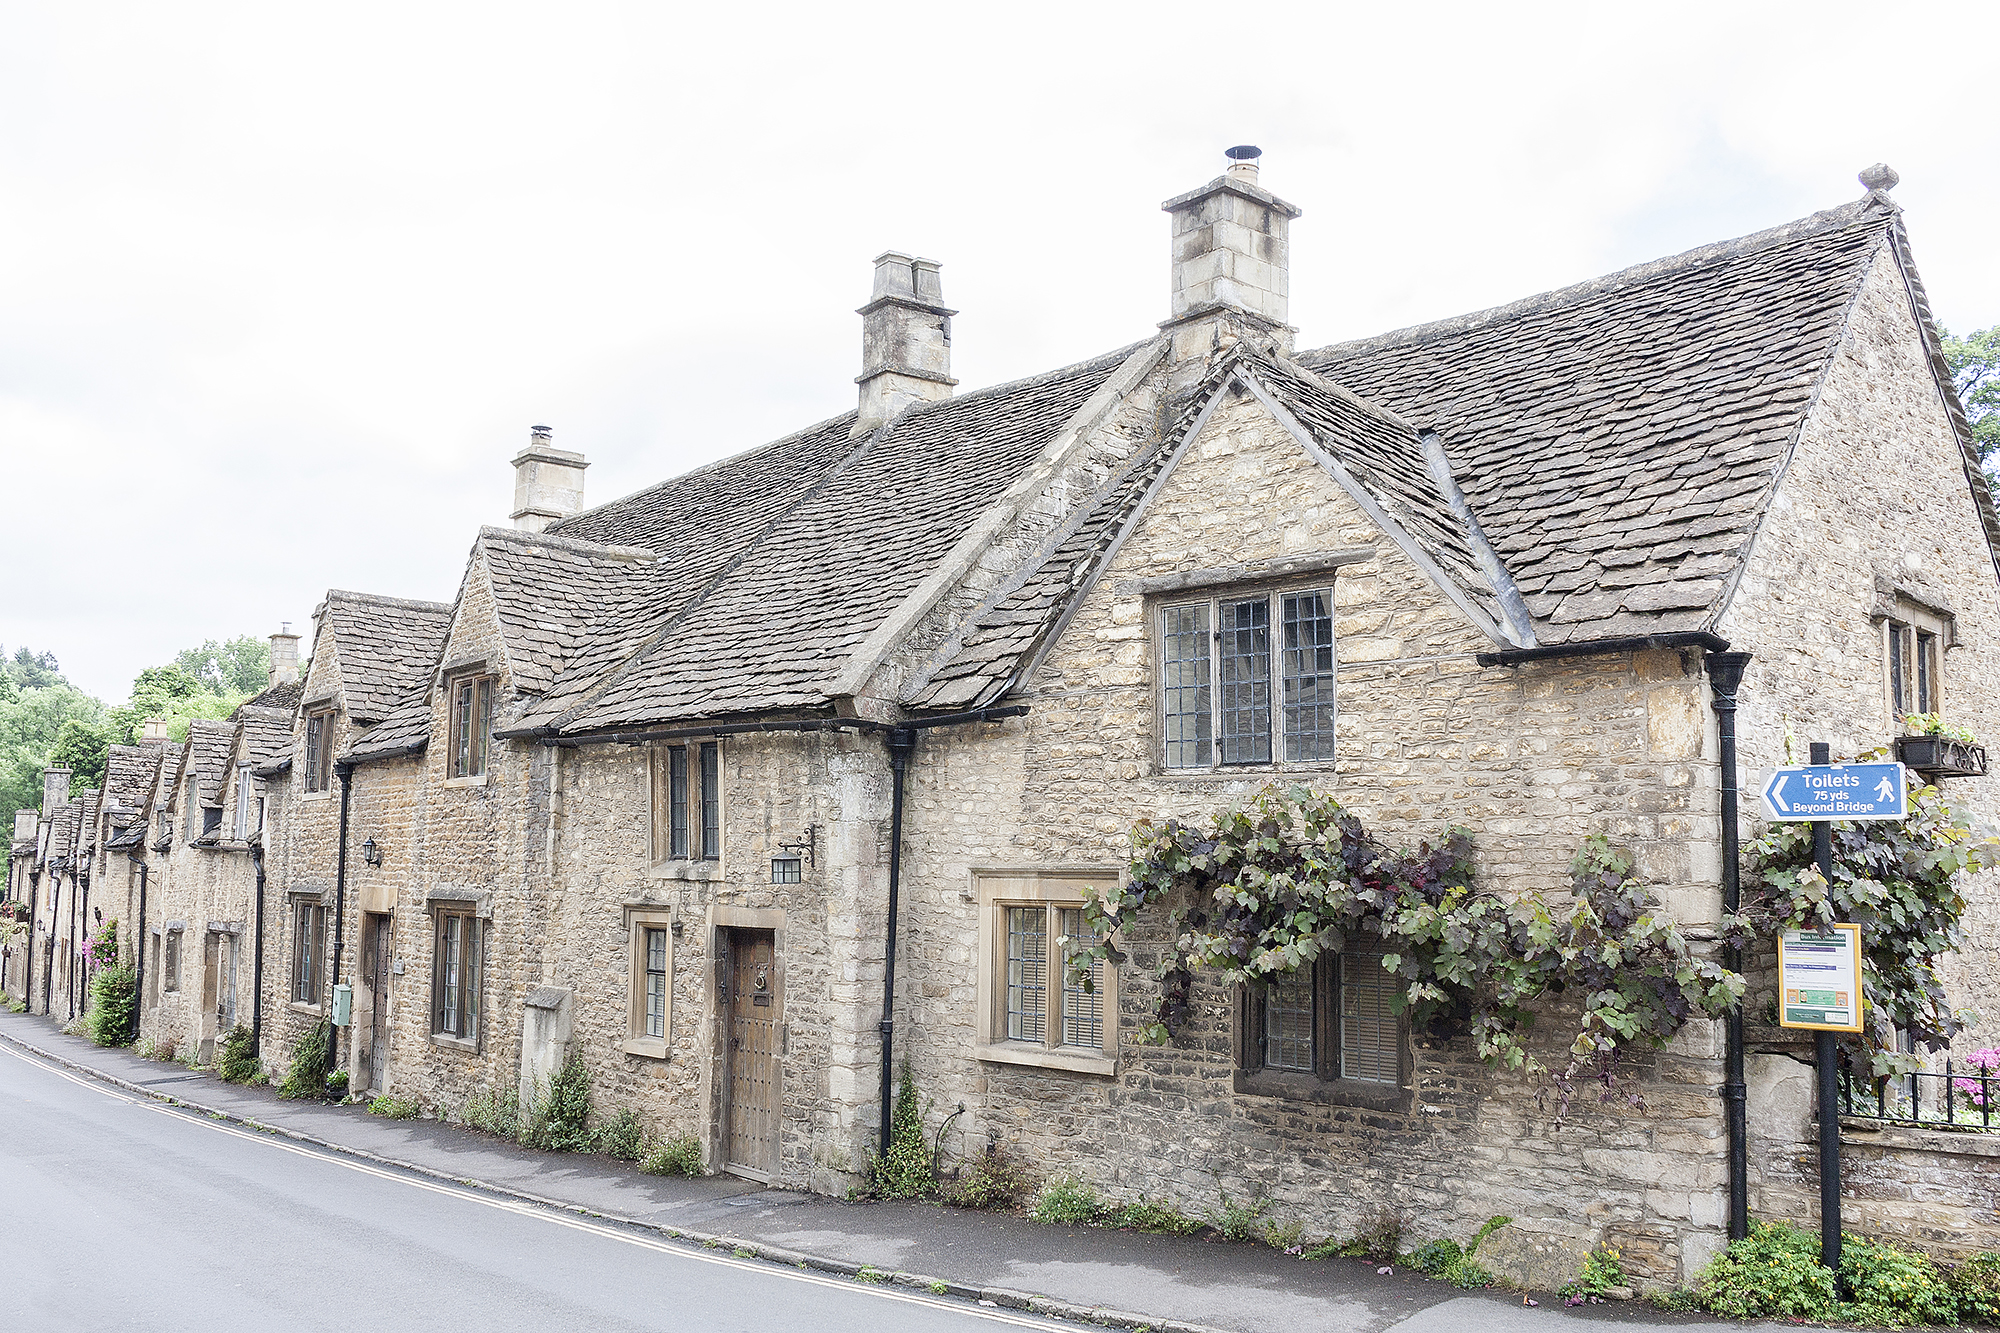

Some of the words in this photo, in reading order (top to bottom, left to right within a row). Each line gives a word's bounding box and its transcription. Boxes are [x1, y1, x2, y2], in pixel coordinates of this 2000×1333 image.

[1802, 773, 1860, 788] Toilets
[1813, 791, 1828, 801] 75
[1830, 790, 1850, 802] yds
[1793, 802, 1834, 813] Beyond
[1836, 802, 1874, 813] Bridge
